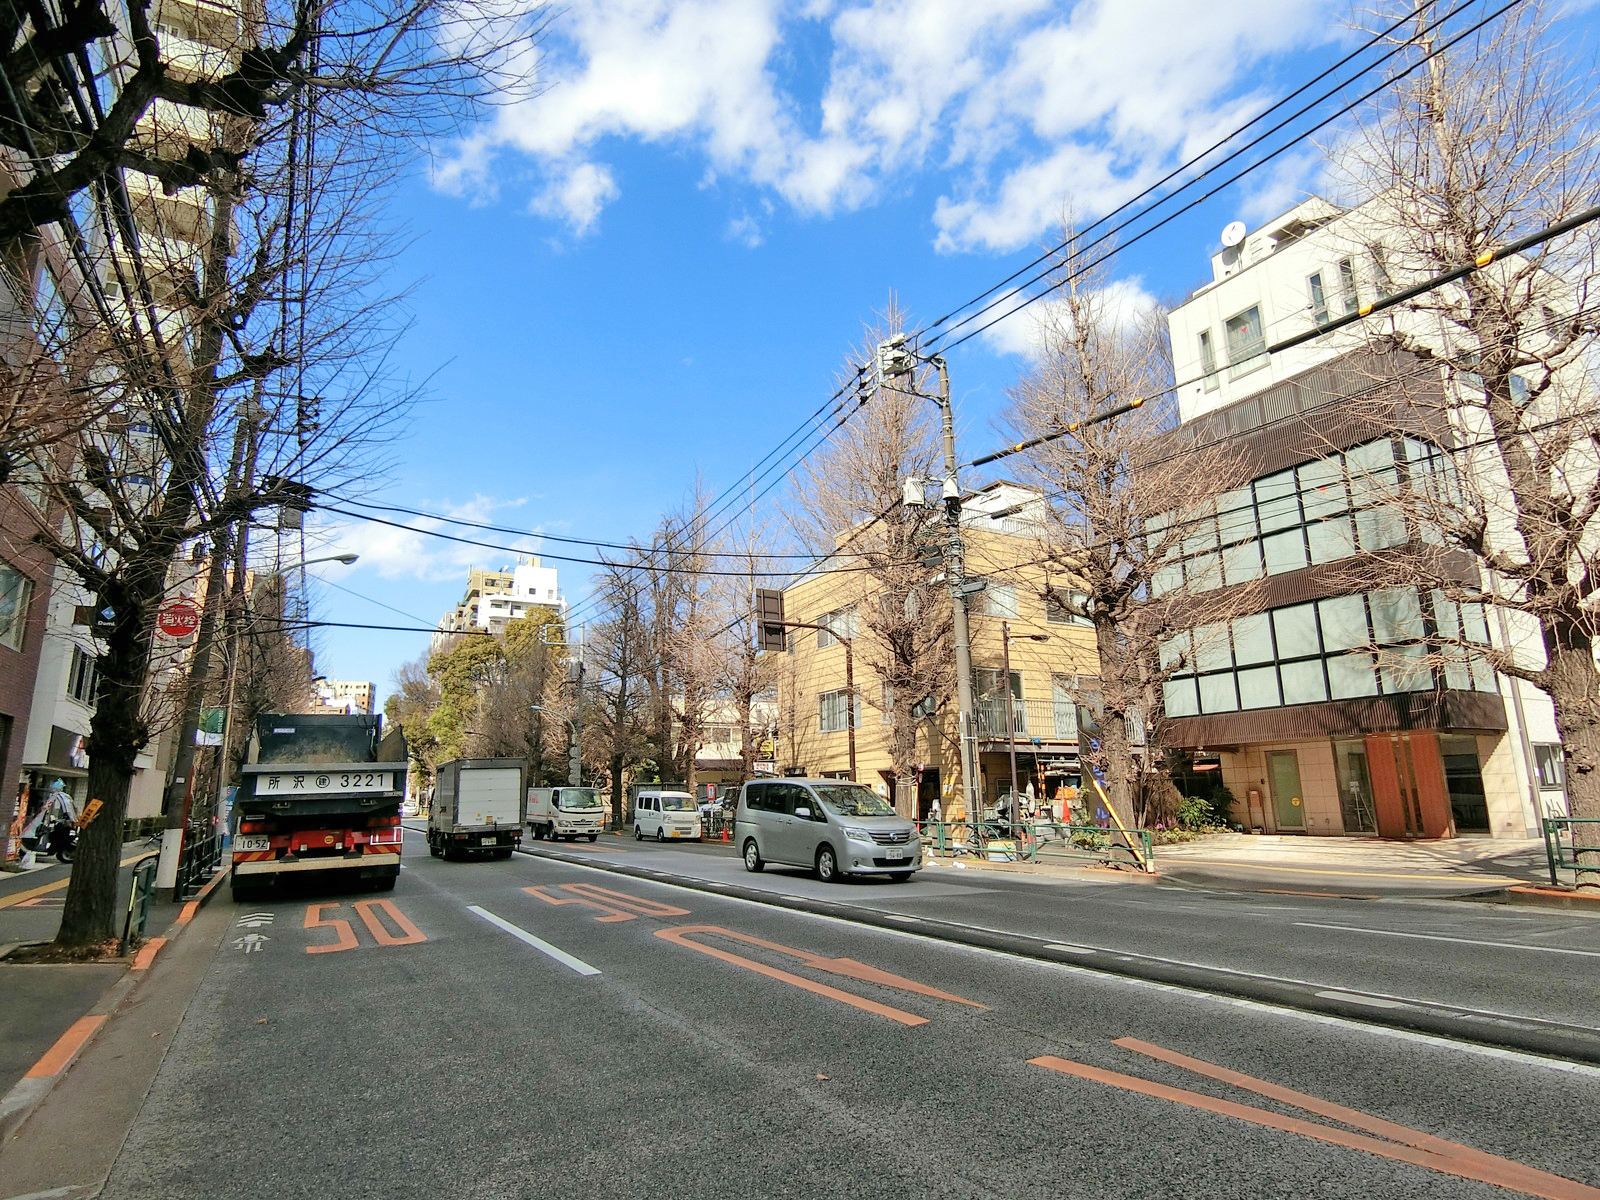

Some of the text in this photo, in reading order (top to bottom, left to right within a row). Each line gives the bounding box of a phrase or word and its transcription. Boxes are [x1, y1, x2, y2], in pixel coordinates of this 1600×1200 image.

[162, 613, 196, 627] 消火栓
[340, 774, 384, 788] 3221
[303, 899, 429, 954] 50
